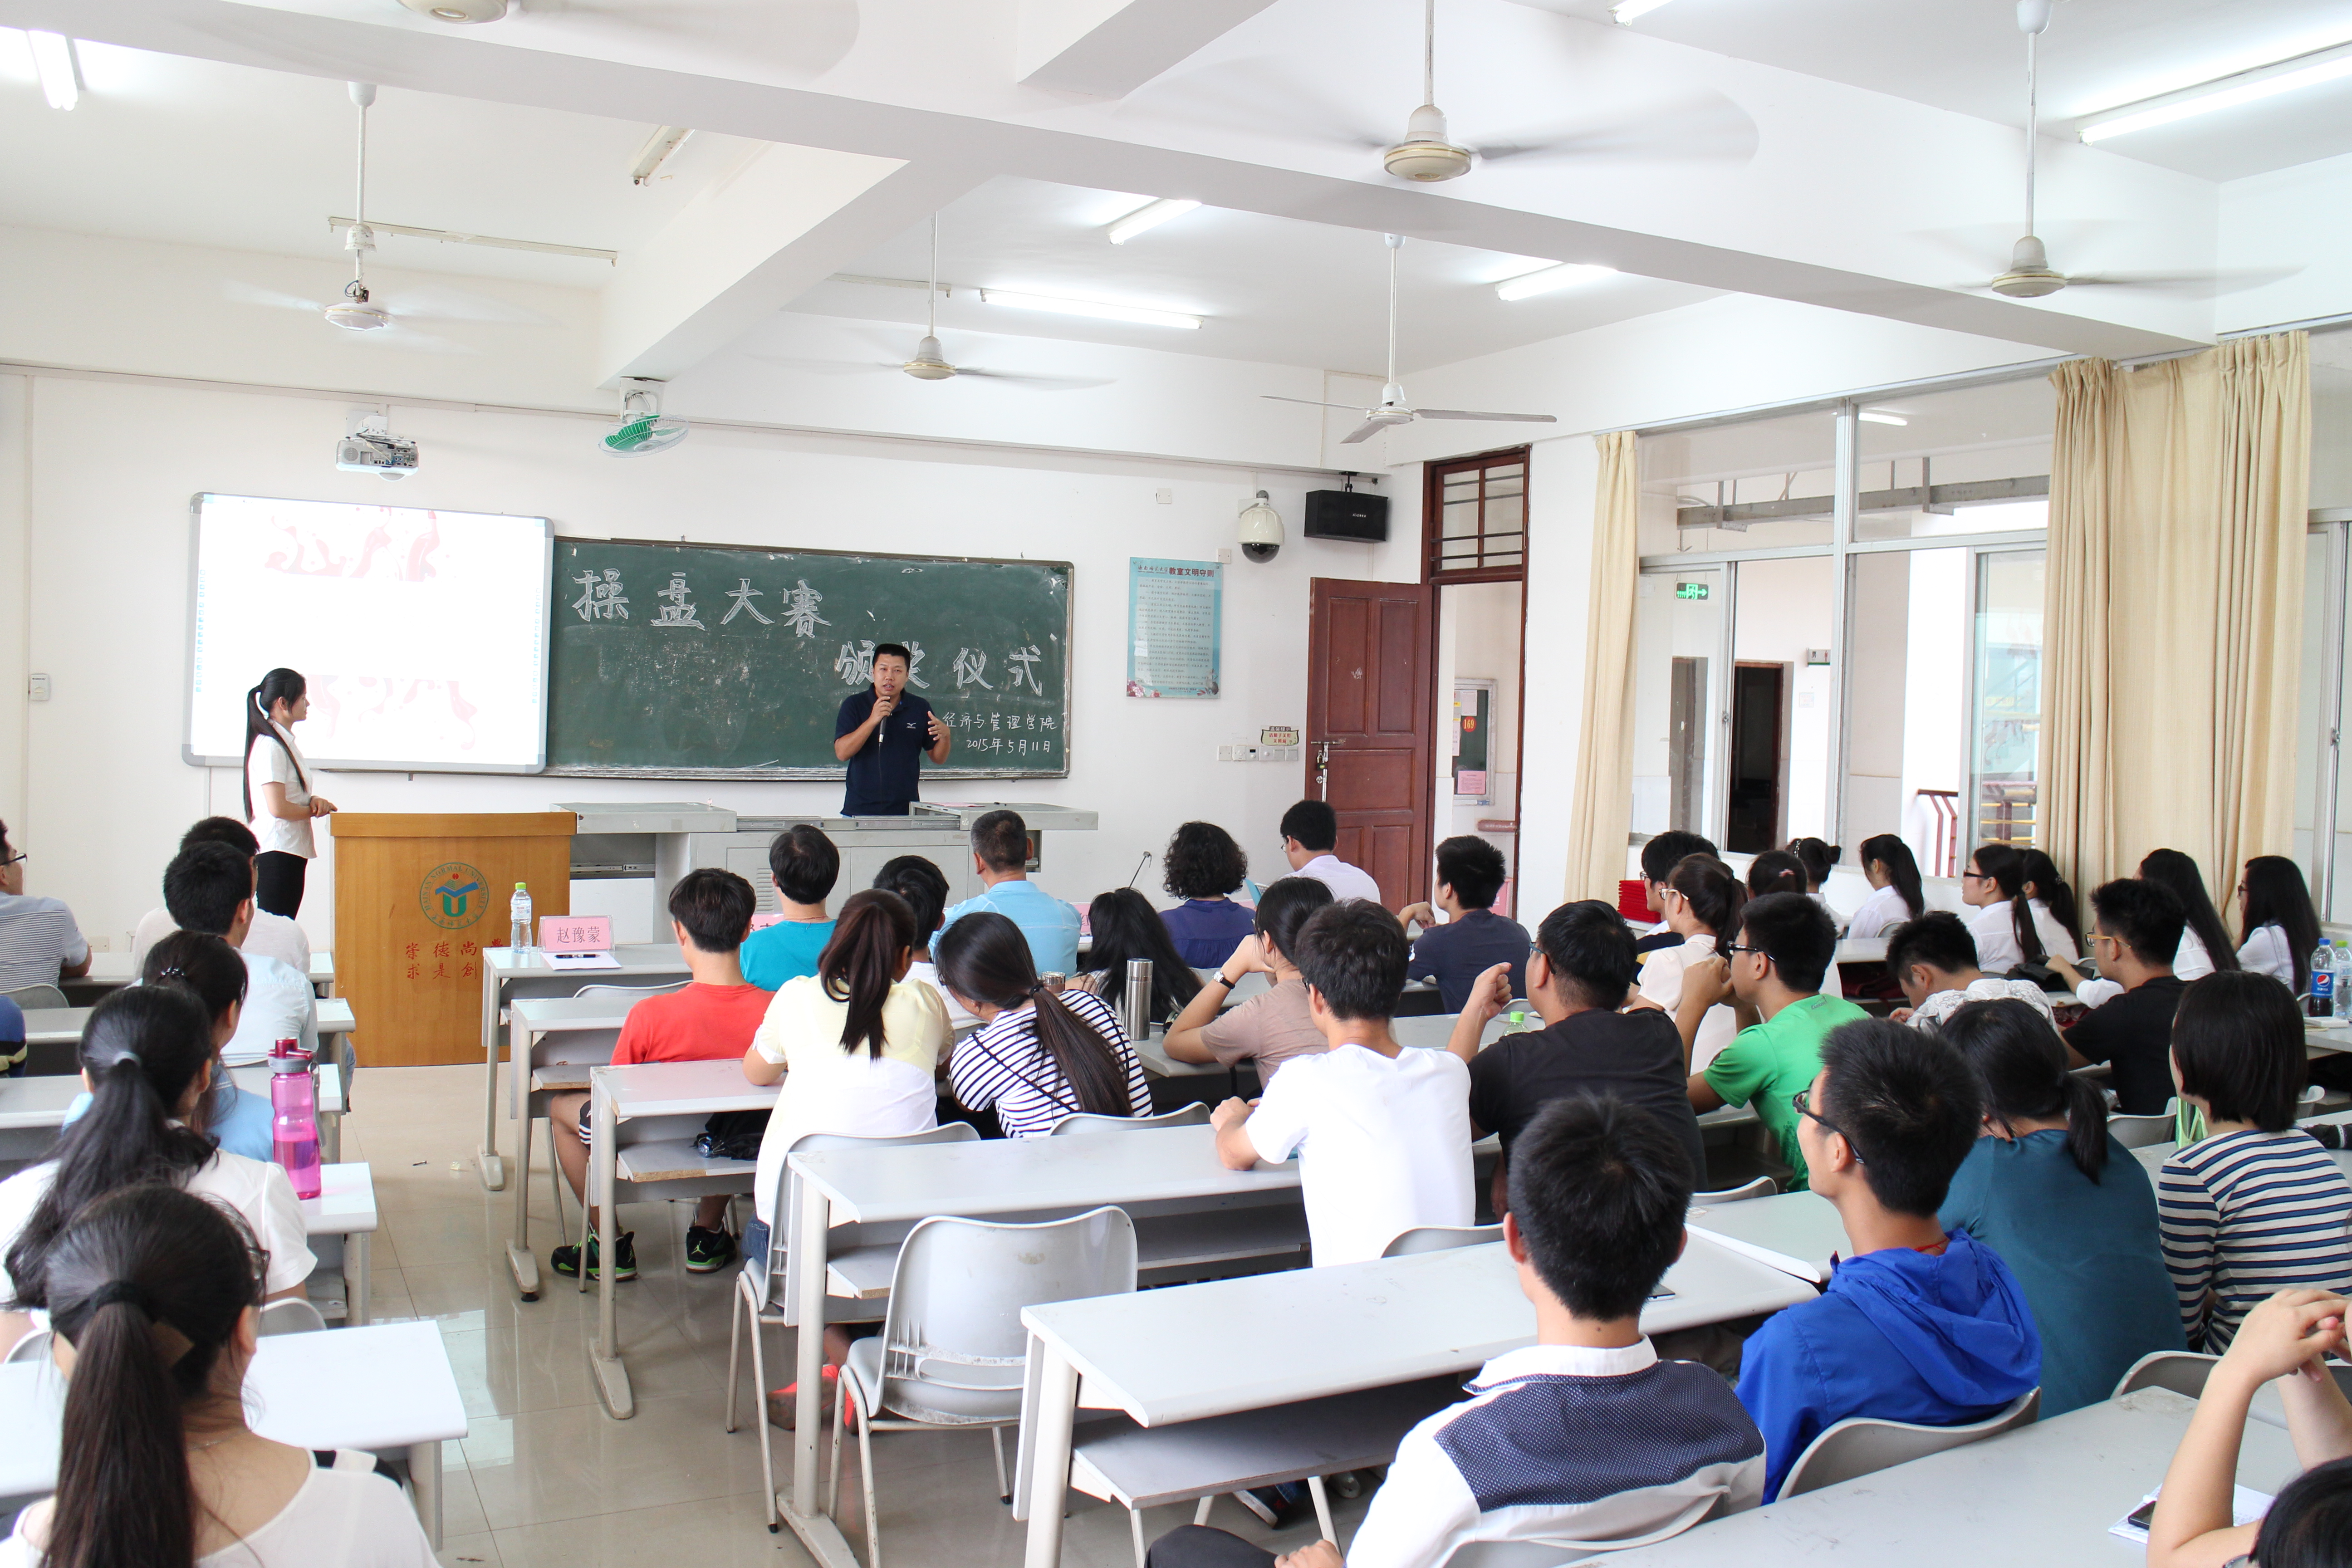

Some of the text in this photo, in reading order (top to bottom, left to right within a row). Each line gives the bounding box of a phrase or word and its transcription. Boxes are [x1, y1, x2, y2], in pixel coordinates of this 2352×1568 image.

[1169, 567, 1214, 577] 教室文明守则
[572, 568, 831, 638] 操盘大赛
[942, 712, 1058, 732] 经济与管理学院
[1464, 719, 1474, 730] 169
[431, 866, 462, 880] NORMAL
[466, 867, 486, 909] UNIVERSITY
[556, 926, 601, 944] 赵豫蒙
